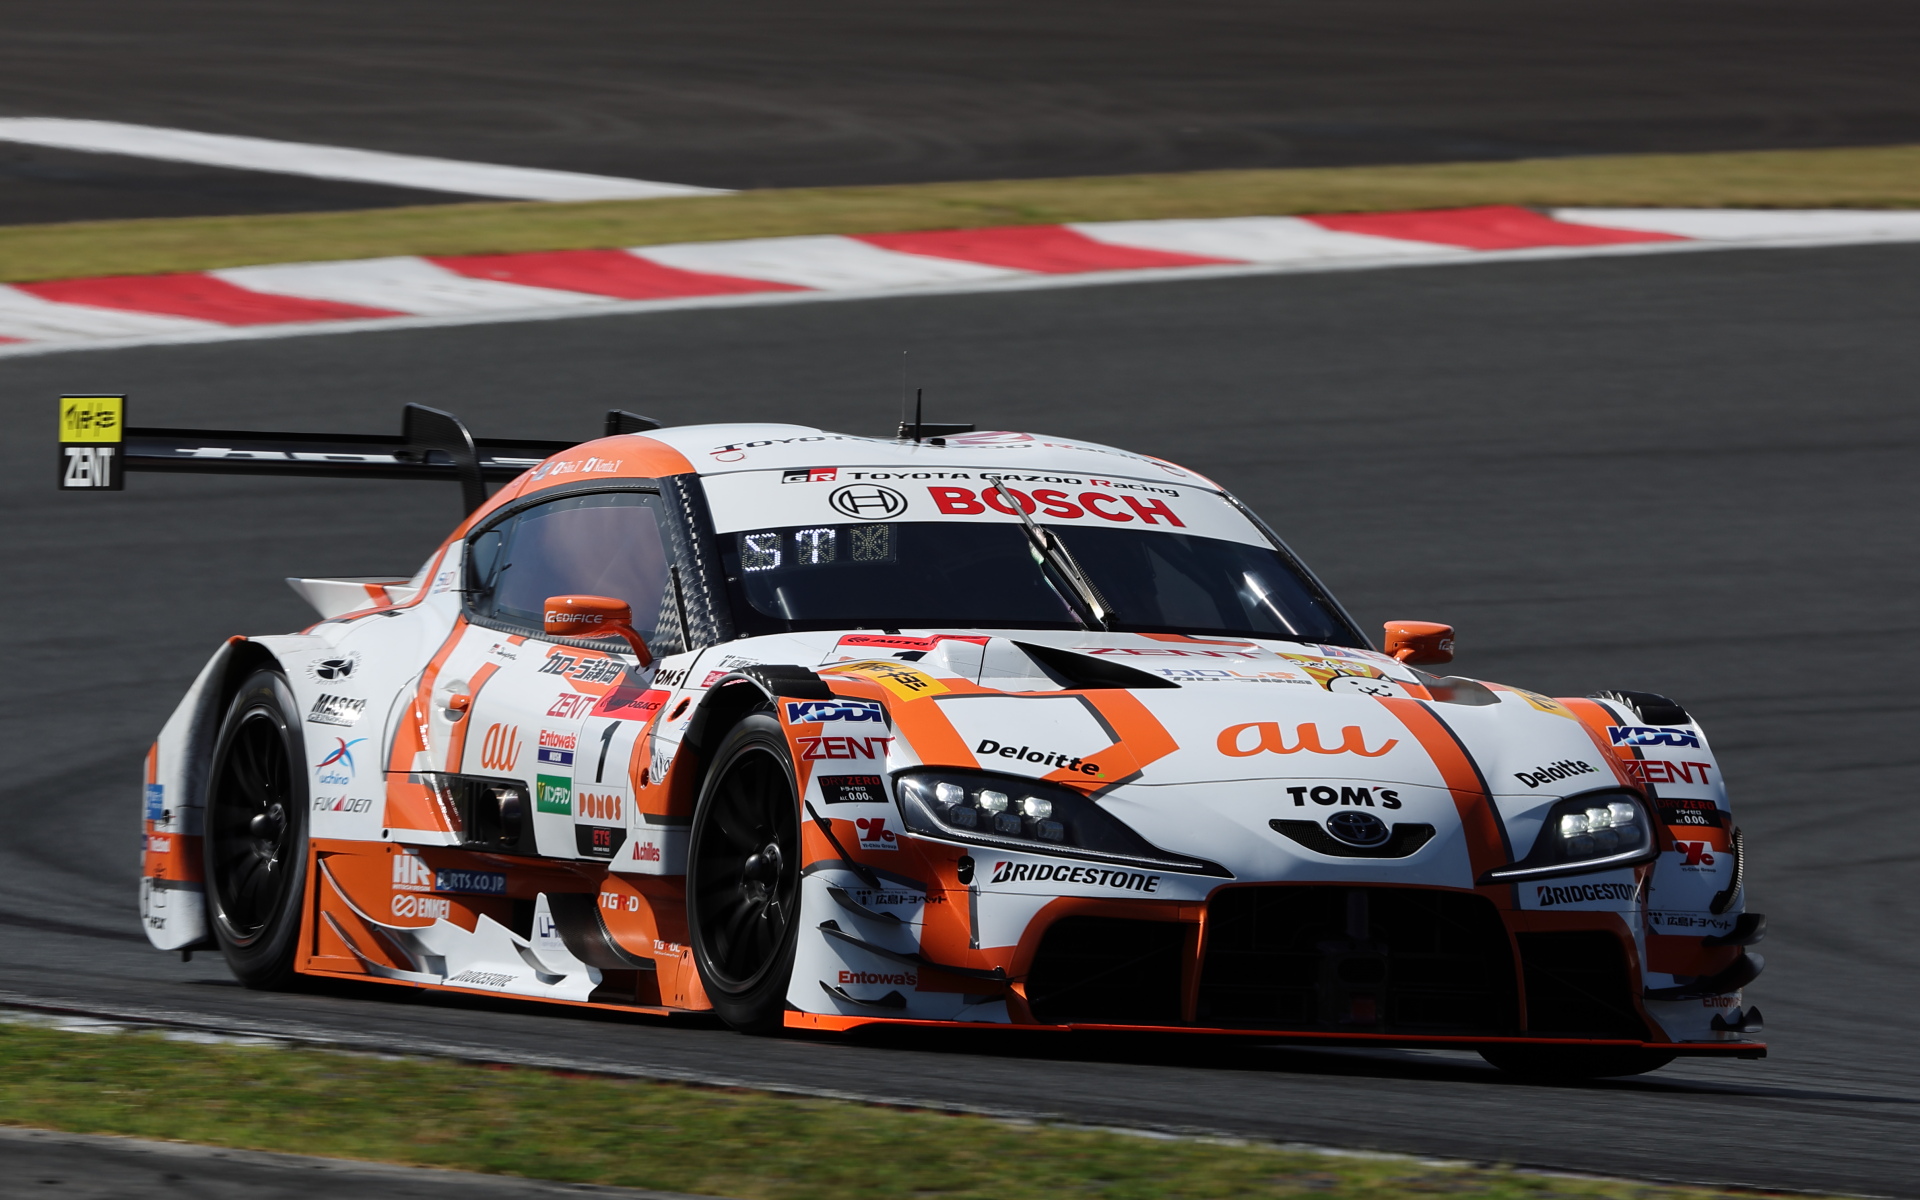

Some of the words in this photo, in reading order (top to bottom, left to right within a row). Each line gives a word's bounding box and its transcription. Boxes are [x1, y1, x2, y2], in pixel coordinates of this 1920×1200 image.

[64, 447, 115, 487] ZENT
[782, 469, 837, 484] GR
[847, 472, 971, 480] TOYOTA
[980, 472, 1082, 485] GAZOO
[1089, 479, 1180, 498] Racing
[927, 486, 1187, 528] BOSCH
[556, 613, 604, 624] EDIFICE
[546, 692, 602, 720] ZENT
[786, 702, 883, 724] KDDI
[482, 722, 522, 772] au
[538, 729, 578, 750] Entowa's
[797, 736, 896, 761] ZENT
[1216, 721, 1400, 758] au
[1606, 726, 1701, 749] KDDI
[595, 720, 622, 784] 1
[820, 776, 845, 787] DRY
[846, 776, 881, 786] ZERO
[1622, 759, 1712, 785] ZENT
[578, 792, 622, 821] PONOS
[1287, 785, 1403, 810] TOM'S
[1681, 800, 1715, 811] ZERO
[593, 829, 611, 846] ETS
[632, 840, 660, 862] Achilles
[991, 860, 1161, 893] BRIDGESTONE
[1537, 881, 1642, 907] BRIDGESTONE
[417, 898, 451, 919] ENKEI
[839, 970, 917, 986] Entowa's
